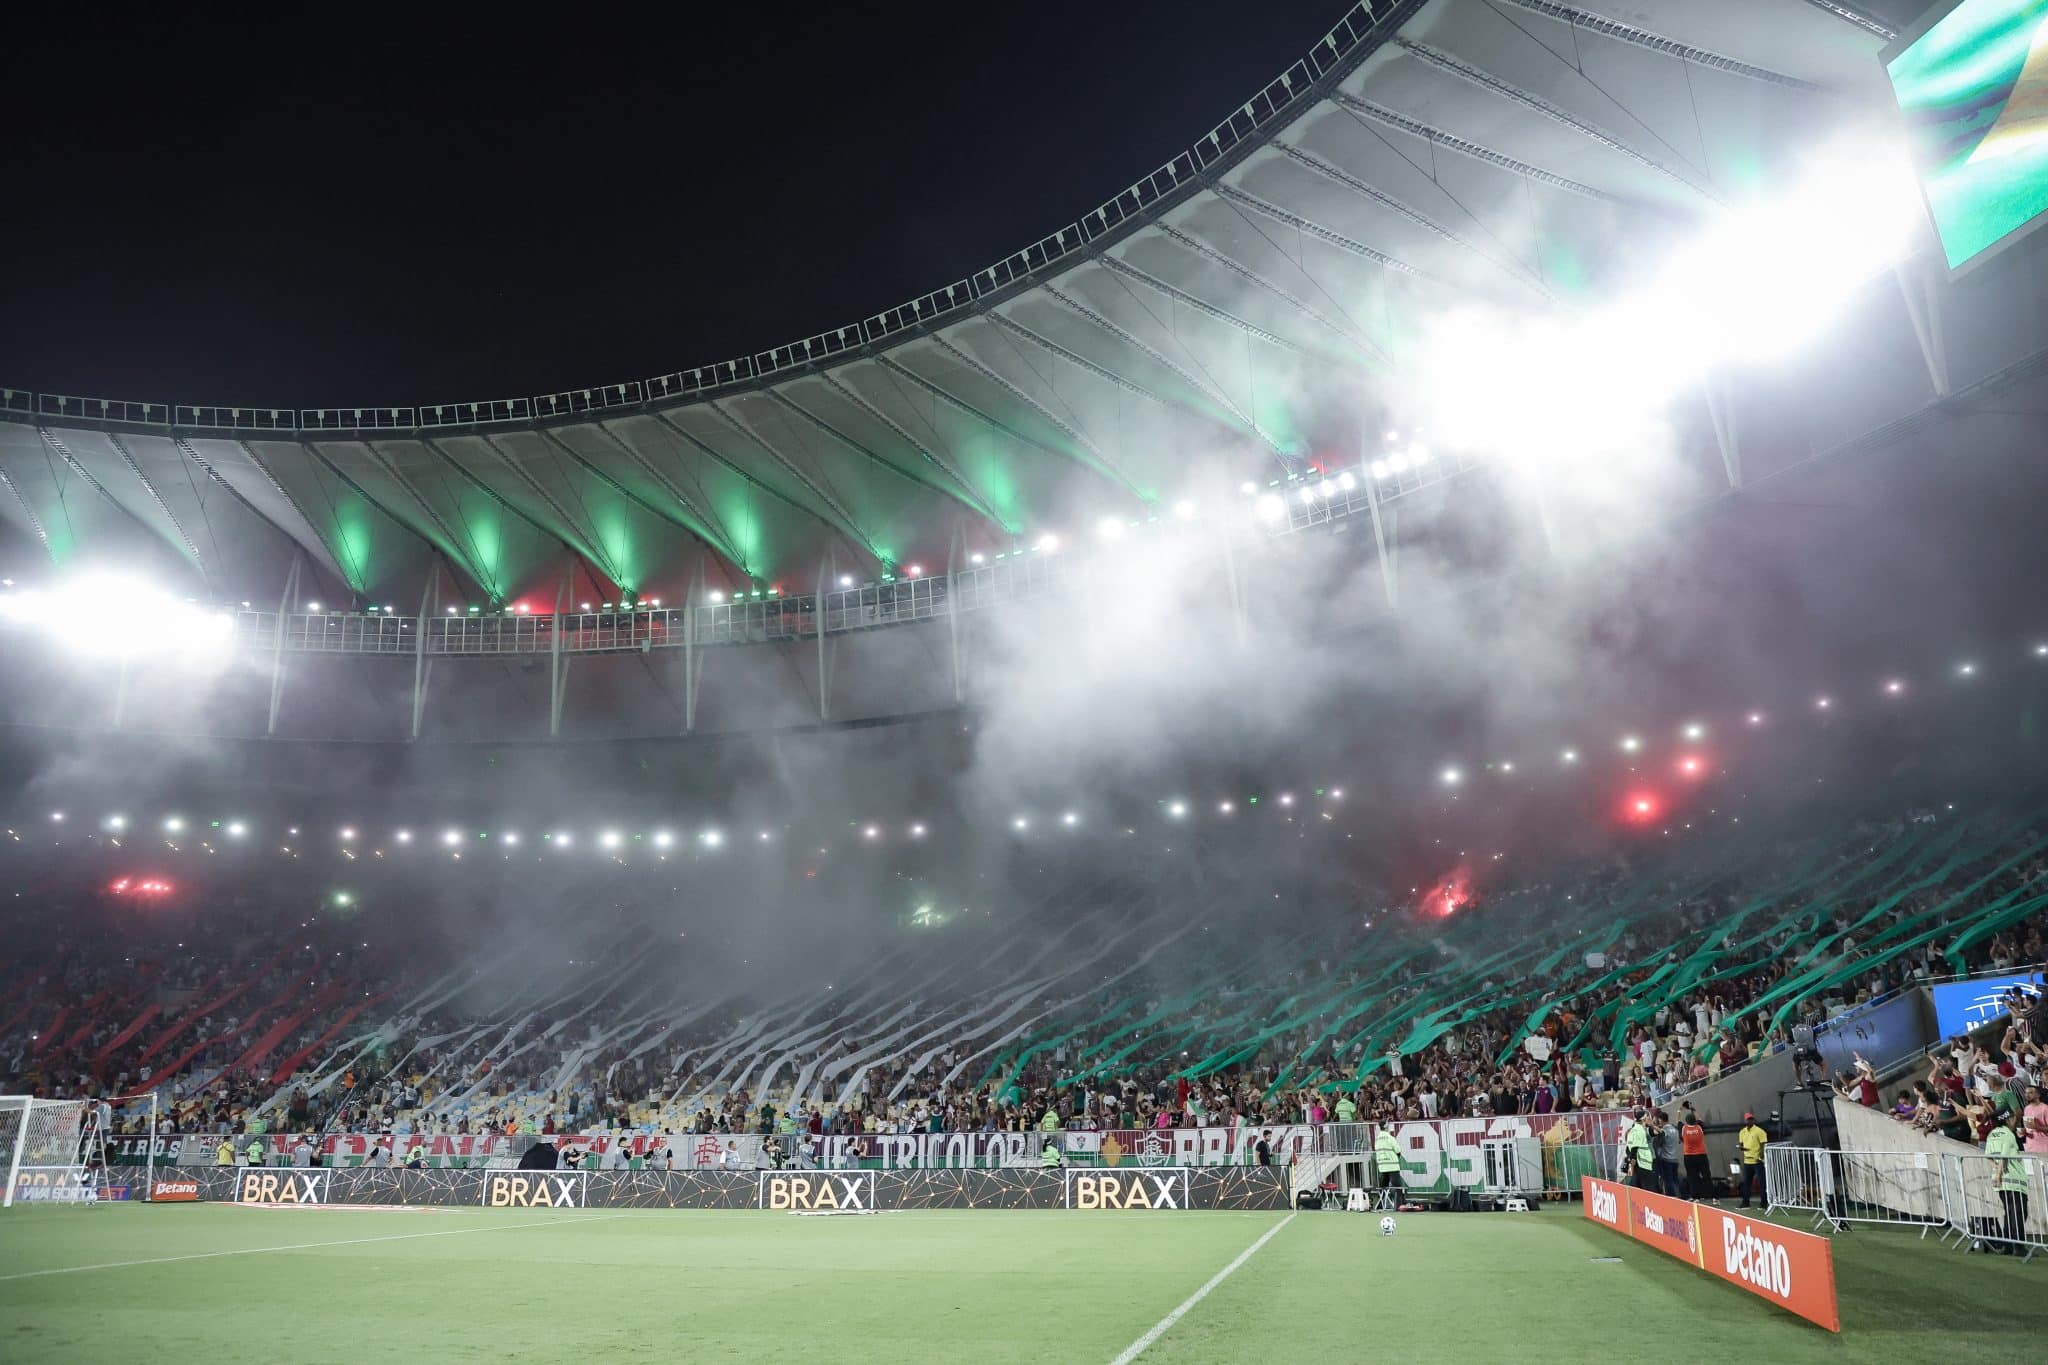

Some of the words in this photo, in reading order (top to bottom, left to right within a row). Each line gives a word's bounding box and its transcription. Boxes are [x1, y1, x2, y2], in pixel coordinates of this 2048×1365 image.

[156, 1182, 198, 1195] Betano
[242, 1174, 322, 1204] BRAX
[490, 1177, 577, 1208] BRAX
[770, 1177, 864, 1209] BRAX
[1077, 1175, 1178, 1209] BRAX
[1591, 1181, 1617, 1224] Betano
[1644, 1206, 1664, 1234] Betano
[1722, 1216, 1791, 1298] Betano
